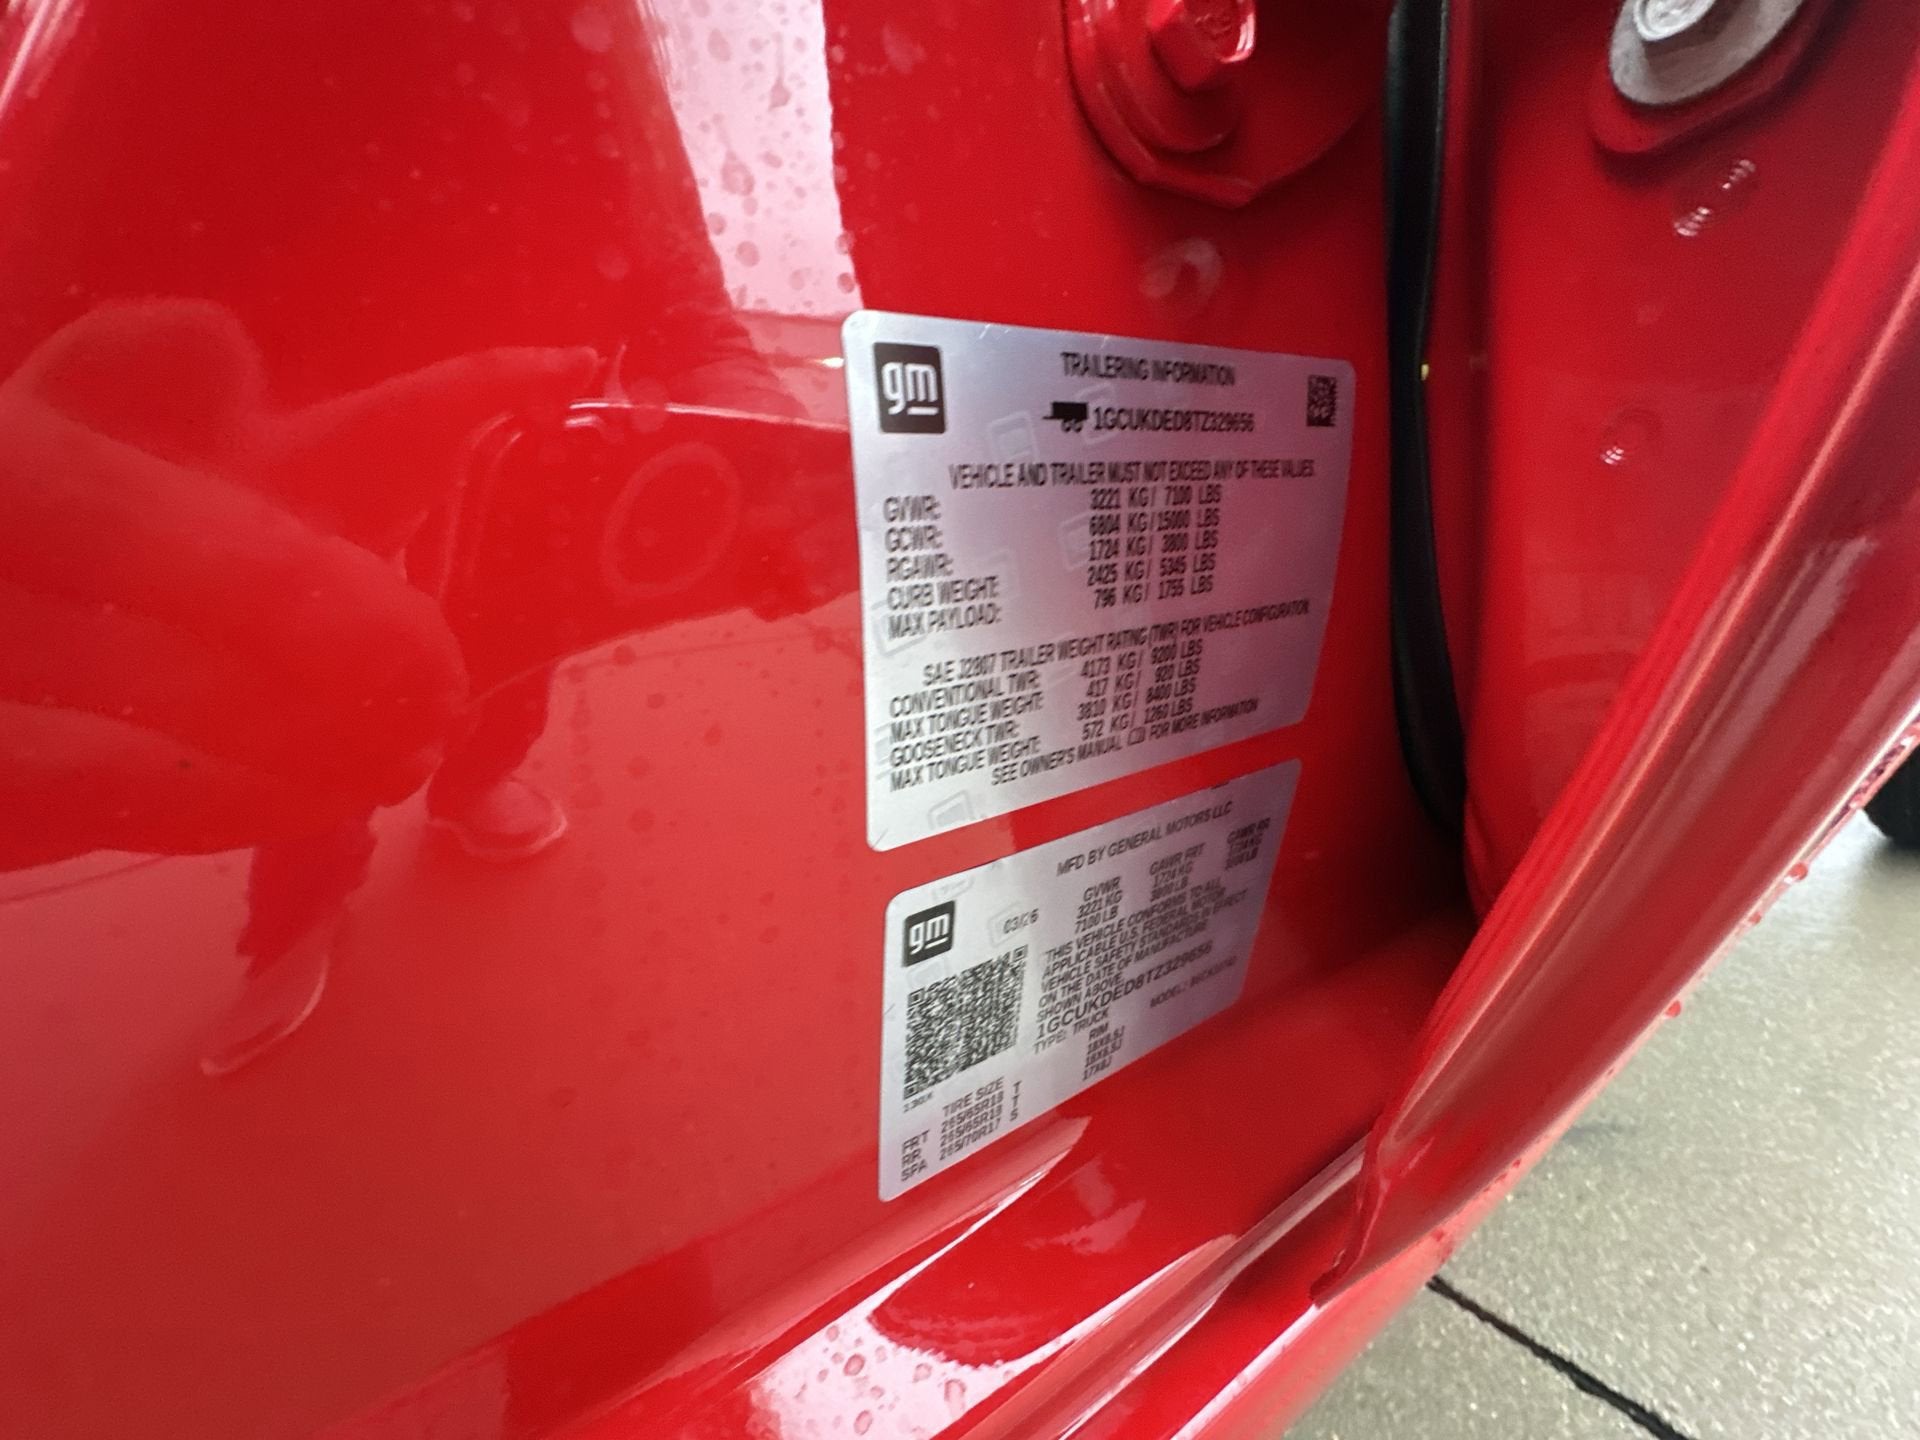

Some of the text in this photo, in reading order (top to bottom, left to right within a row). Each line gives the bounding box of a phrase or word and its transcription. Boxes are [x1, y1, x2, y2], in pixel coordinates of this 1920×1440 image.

[881, 361, 939, 416] gm
[1059, 351, 1236, 384] TRAILERING INFORMATION
[949, 464, 1018, 486] VEHICLE
[1017, 464, 1048, 484] AND
[1050, 463, 1105, 483] TRAILER
[1107, 462, 1142, 481] MUST
[1143, 462, 1168, 480] NOT
[1168, 461, 1212, 479] EXCEED
[1212, 460, 1234, 478] ANY
[1234, 460, 1250, 477] OF
[1090, 488, 1122, 509] 3221
[1197, 484, 1223, 503] LBS
[1195, 508, 1221, 527] LBS
[1088, 539, 1120, 560] 1724
[1194, 530, 1219, 550] LBS
[887, 583, 935, 609] CURB
[939, 576, 1000, 603] WEIGHT:
[1087, 563, 1119, 585] 2425
[1192, 553, 1217, 573] LBS
[888, 612, 924, 638] MAX
[926, 602, 1002, 632] PAYLOAD:
[1189, 575, 1214, 596] LBS
[921, 659, 956, 684] SAE
[999, 643, 1055, 671] TRAILER
[1055, 635, 1105, 661] WEIGHT
[1105, 628, 1148, 652] RATING
[1179, 619, 1202, 639] FOR
[1200, 612, 1242, 635] VEHICLE
[888, 676, 1006, 717] CONVENTIONAL
[1179, 640, 1204, 660] LBS
[890, 715, 925, 741] MAX
[927, 702, 988, 733] TONGUE
[1177, 659, 1201, 680] LBS
[889, 726, 984, 765] GOOSENECK
[1173, 679, 1197, 700] LBS
[890, 762, 925, 790] MAX
[927, 747, 987, 781] TONGUE
[1081, 719, 1105, 742] 572
[1169, 698, 1194, 720] LBS
[991, 759, 1019, 784] SEE
[1076, 733, 1123, 762] MANUAL
[1148, 721, 1170, 743] FOR
[1169, 714, 1201, 737] MORE
[1056, 801, 1233, 875] MFD BY GENERAL MOTORS LLC
[1148, 851, 1183, 874] GAWR
[1076, 889, 1123, 919] 3221 KG
[1082, 875, 1121, 901] GVWR
[909, 913, 950, 955] gm
[1101, 905, 1118, 922] LB
[1042, 934, 1117, 978] APPLICABLE
[1043, 939, 1074, 963] THIS
[1075, 918, 1125, 950] VEHICLE
[1038, 988, 1059, 1008] ON
[1059, 976, 1084, 998] THE
[1084, 962, 1116, 987] DATE
[1116, 954, 1133, 972] OF
[1040, 959, 1092, 993] VEHICLE
[1092, 939, 1137, 969] SAFETY
[1036, 991, 1083, 1022] SHOWN
[1071, 1006, 1110, 1035] TRUCK
[901, 1129, 929, 1154] FRT
[1012, 1079, 1022, 1095] T
[941, 1090, 975, 1117] TIRE
[975, 1075, 1005, 1100] SIZE
[1009, 1107, 1019, 1122] S
[901, 1146, 922, 1167] RR
